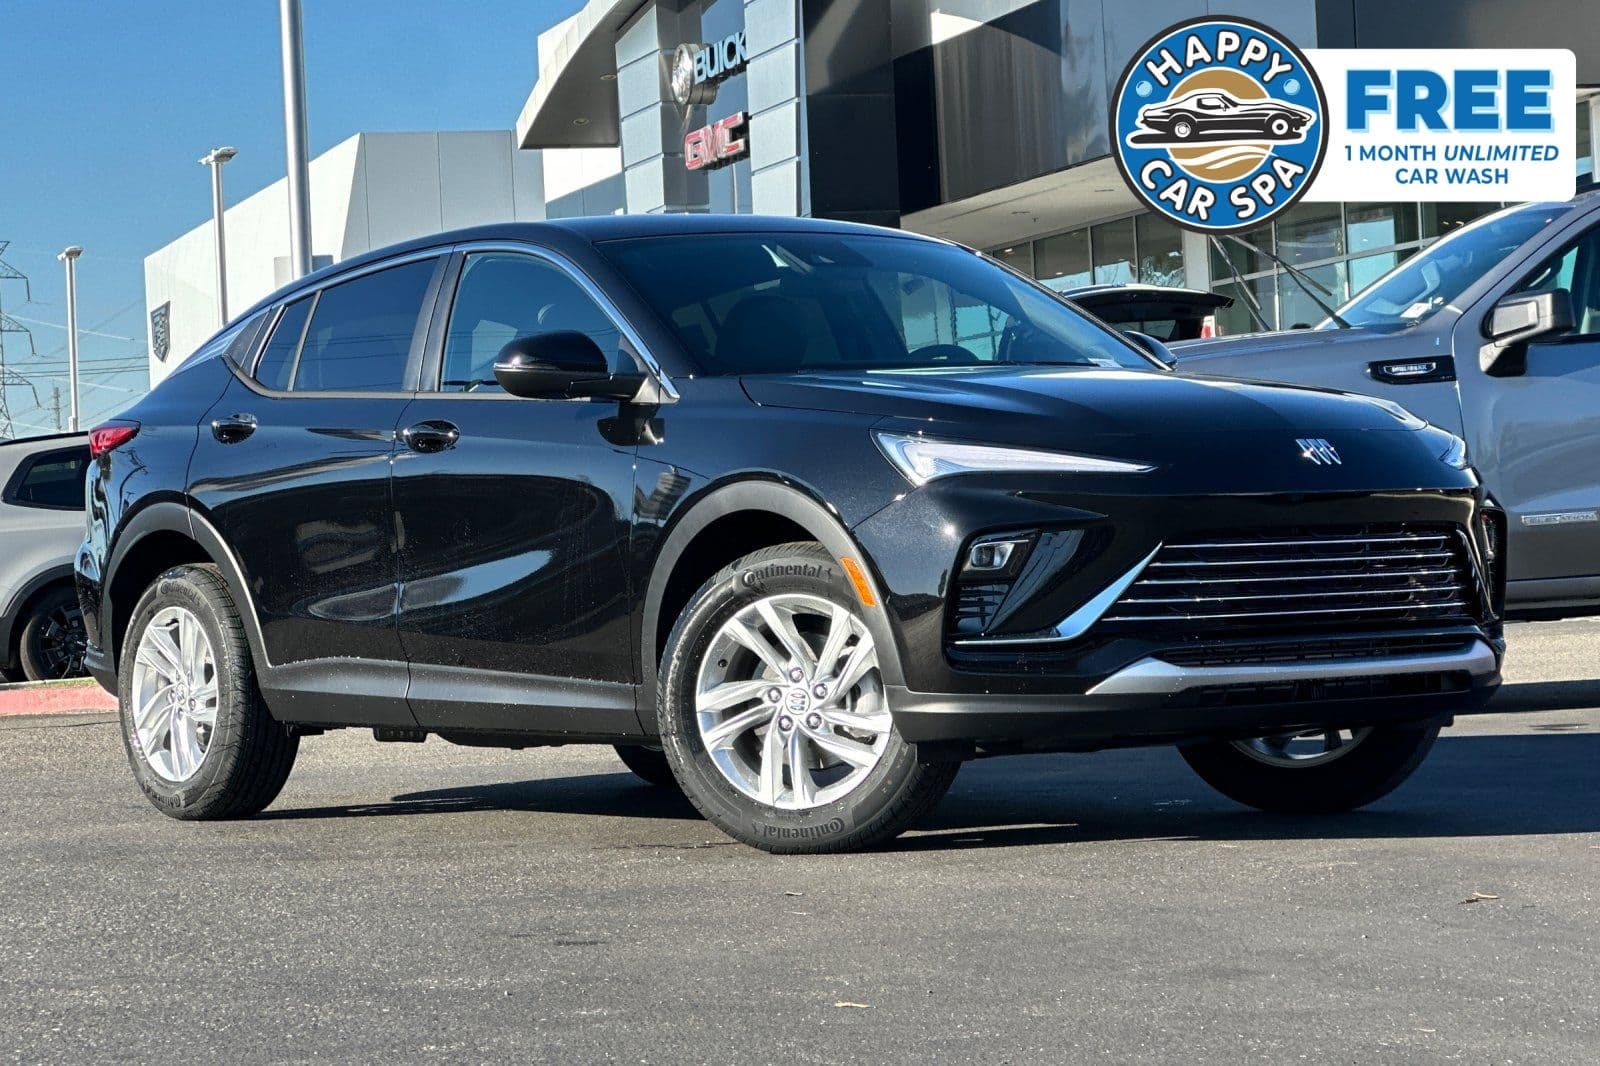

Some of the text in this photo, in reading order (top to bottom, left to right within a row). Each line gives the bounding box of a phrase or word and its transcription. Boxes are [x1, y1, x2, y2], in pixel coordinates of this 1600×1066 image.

[694, 31, 748, 85] BUICK
[685, 111, 745, 170] GMC
[741, 563, 823, 588] Continental
